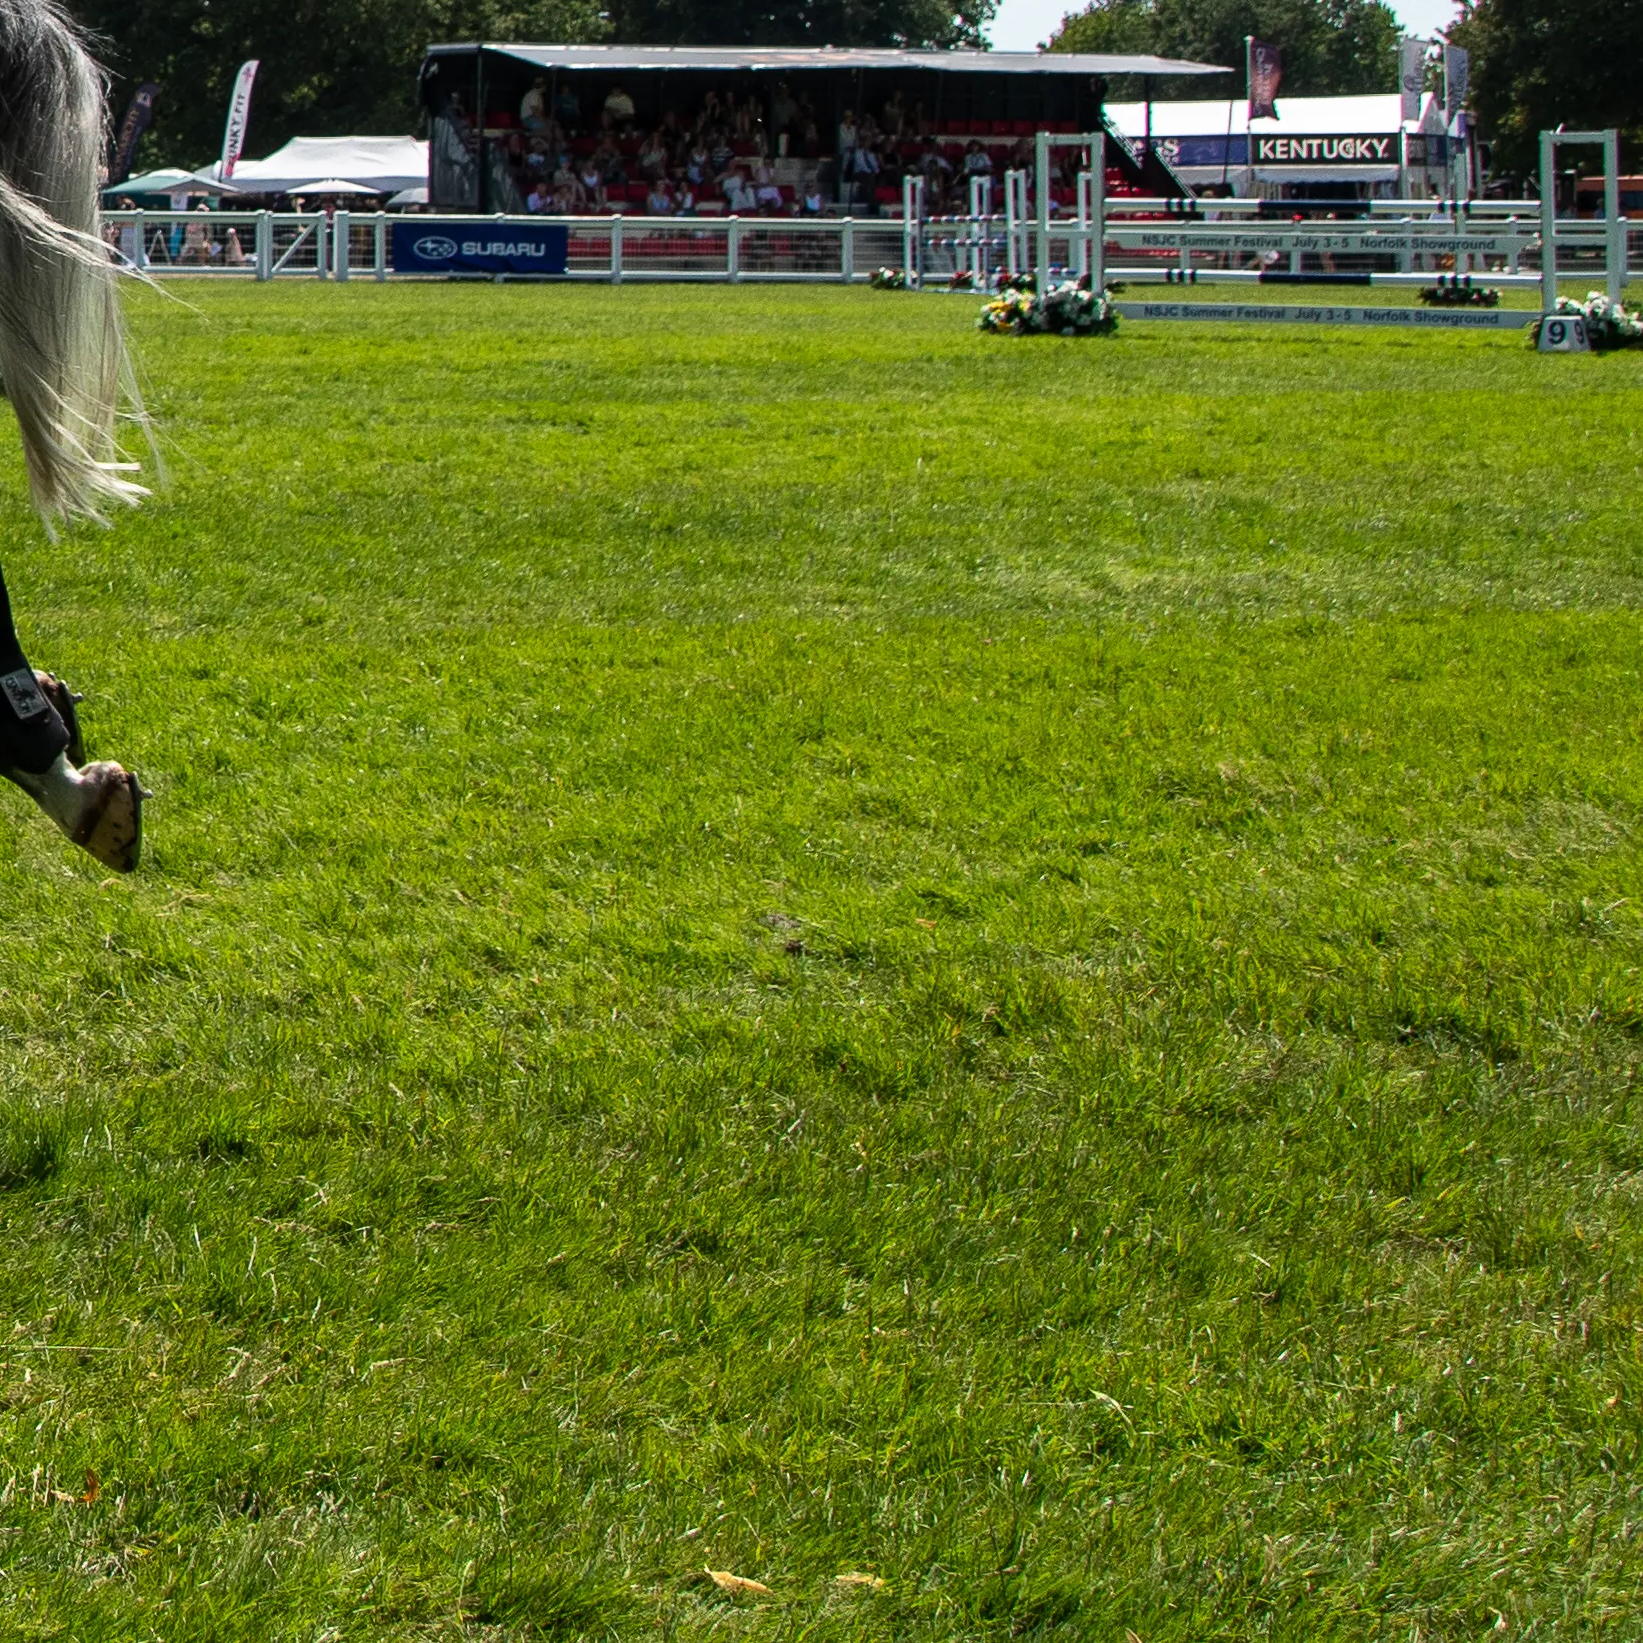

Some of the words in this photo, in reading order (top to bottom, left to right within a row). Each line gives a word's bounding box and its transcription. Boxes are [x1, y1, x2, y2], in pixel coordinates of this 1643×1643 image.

[1259, 138, 1388, 159] KENTUCKY
[462, 241, 546, 256] SUBARU
[1142, 235, 1176, 246] NSJC
[1179, 235, 1231, 247] Summer
[1234, 236, 1283, 248] Festival
[1292, 236, 1320, 251] July
[1360, 237, 1407, 249] Norfolk
[1411, 238, 1496, 252] Showground
[1144, 306, 1178, 317] NSJC
[1182, 307, 1233, 318] Summer
[1236, 307, 1285, 319] Festival
[1294, 308, 1322, 322] July
[1363, 309, 1410, 321] Norfolk
[1414, 310, 1499, 325] Showground
[1548, 321, 1566, 344] 9
[1574, 322, 1585, 344] 9
